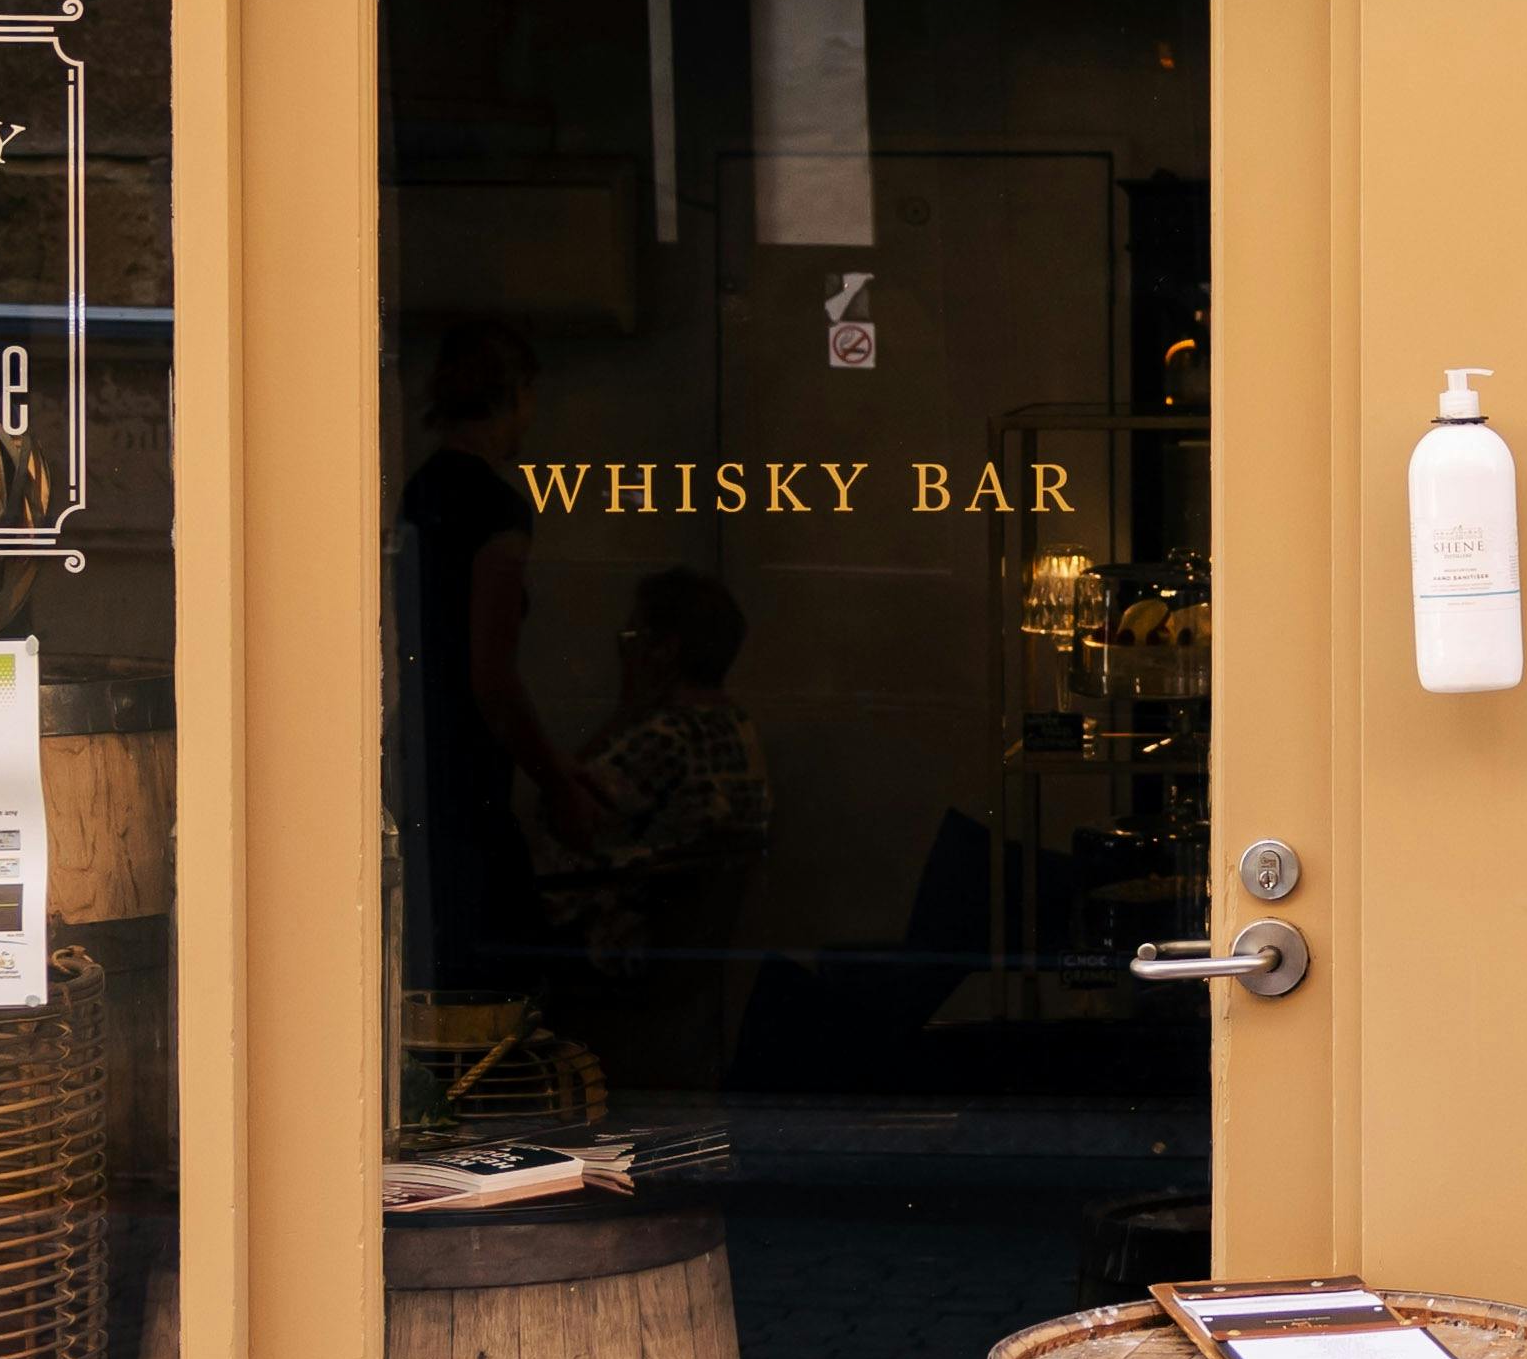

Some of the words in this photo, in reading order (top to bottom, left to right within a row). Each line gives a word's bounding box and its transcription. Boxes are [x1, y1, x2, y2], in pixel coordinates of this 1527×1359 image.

[519, 462, 868, 513] WHISKY
[912, 461, 1076, 513] BAR
[1433, 540, 1485, 553] SHENE
